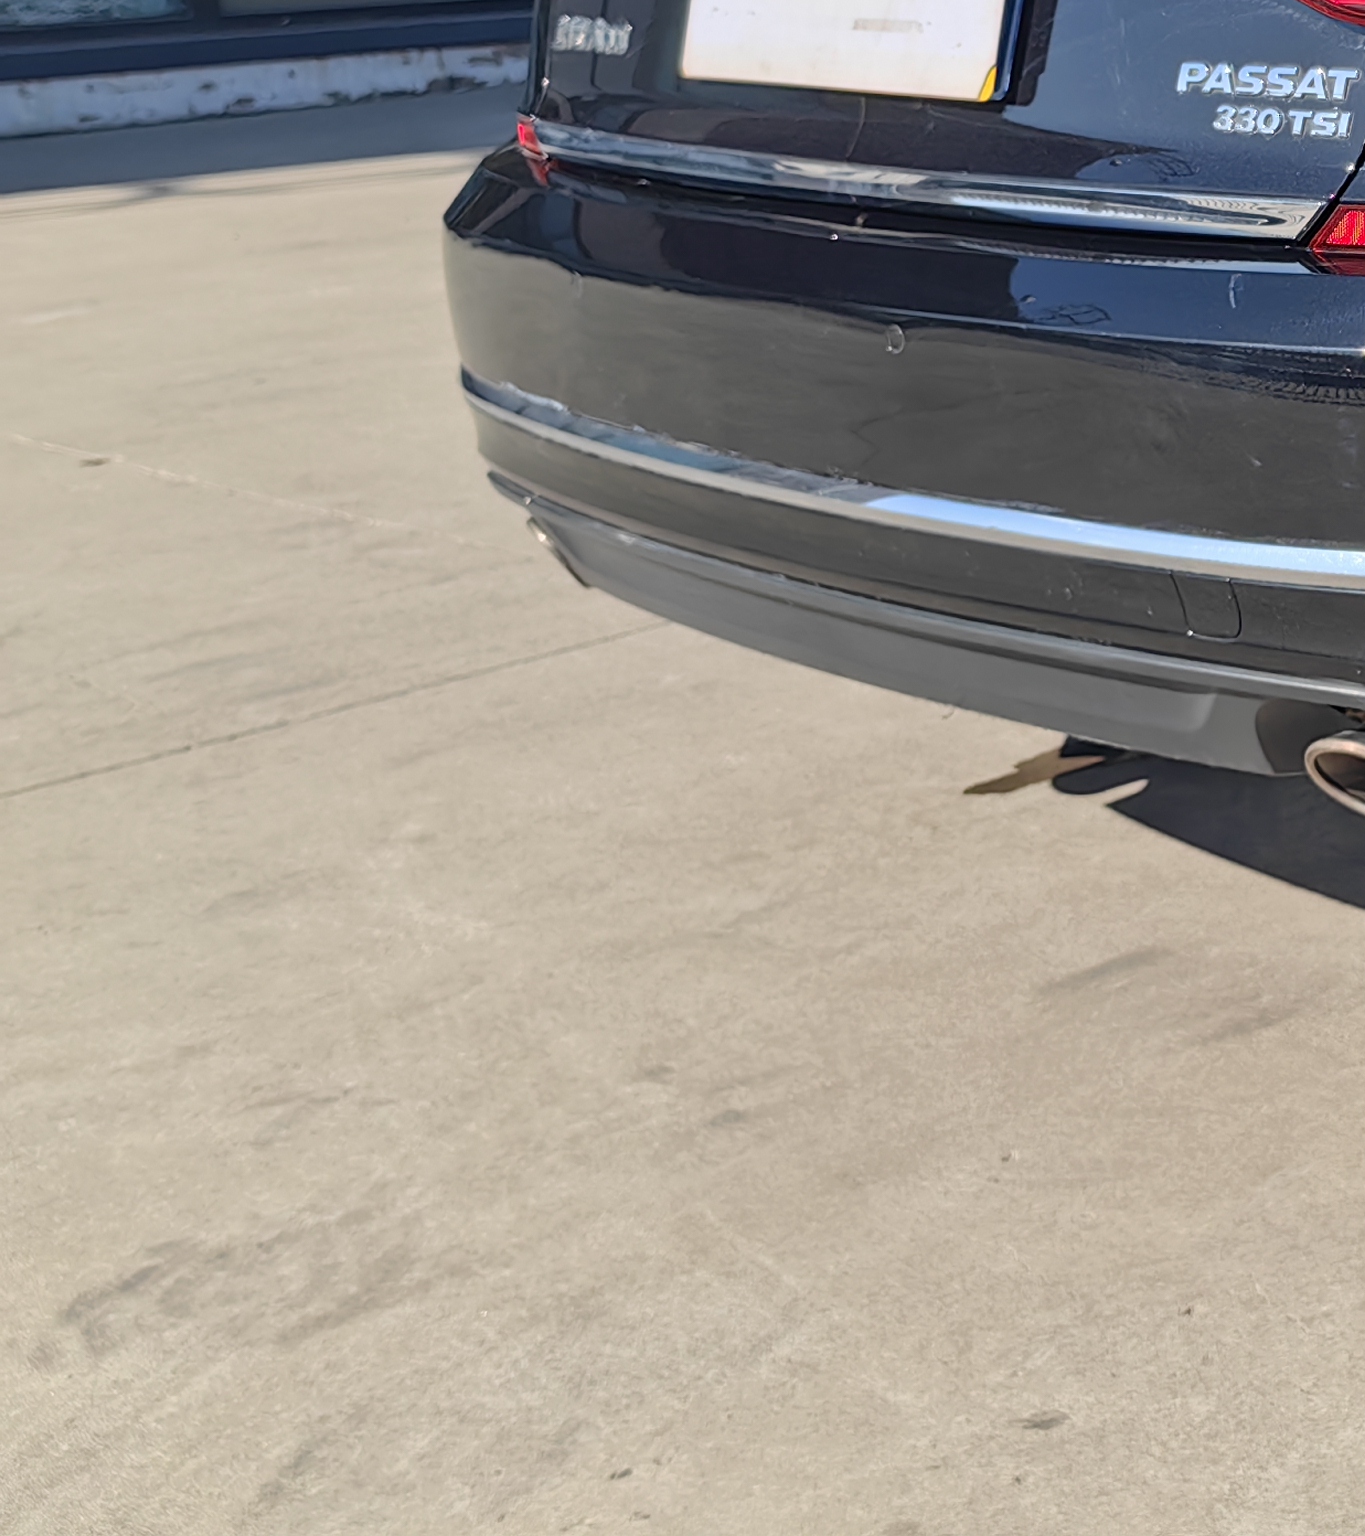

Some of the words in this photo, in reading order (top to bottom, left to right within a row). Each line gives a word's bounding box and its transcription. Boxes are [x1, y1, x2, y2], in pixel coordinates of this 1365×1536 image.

[1176, 61, 1362, 102] PASSAT
[1212, 103, 1285, 138] 330
[1287, 108, 1354, 139] TSI
